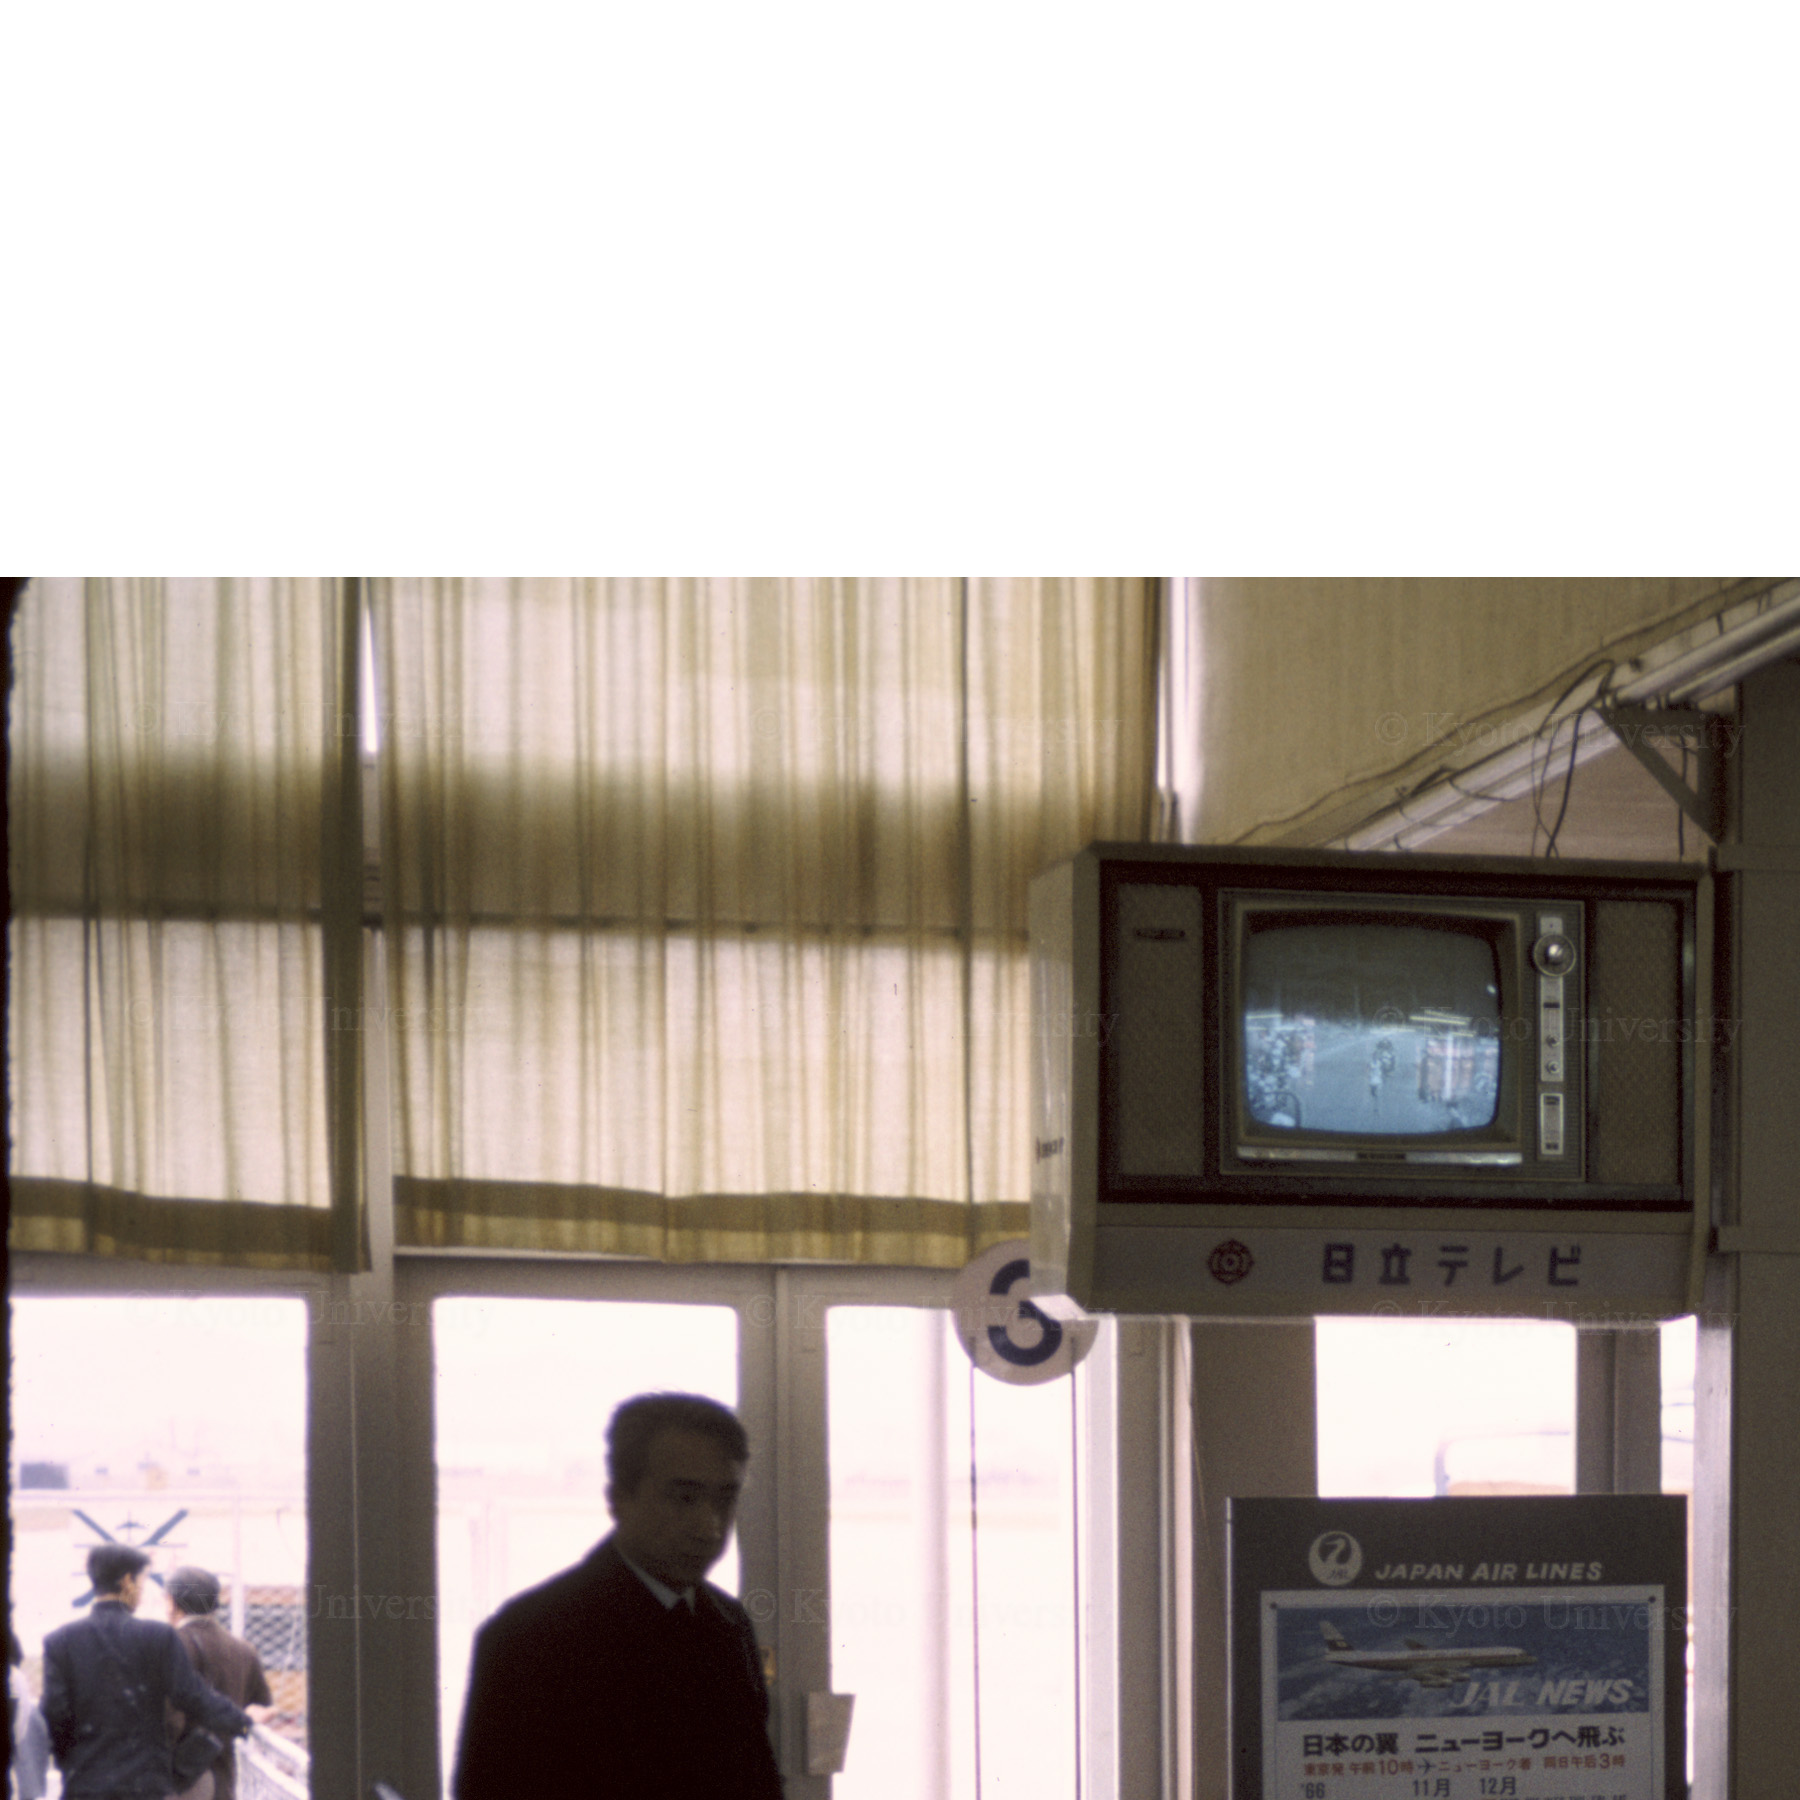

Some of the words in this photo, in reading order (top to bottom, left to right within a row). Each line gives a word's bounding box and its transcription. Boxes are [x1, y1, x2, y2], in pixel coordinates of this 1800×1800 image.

[1322, 1243, 1581, 1287] 日立テレビ
[1374, 1563, 1466, 1582] JAPAN
[1471, 1563, 1518, 1582] AIR
[1526, 1560, 1603, 1580] LINES
[1449, 1681, 1526, 1708] JAL
[1537, 1678, 1634, 1705] NEWS
[1302, 1732, 1399, 1758] 日本の翼
[1415, 1726, 1626, 1754] ニューヨークへ飛ぶ
[1413, 1778, 1450, 1797] 11月
[1480, 1776, 1516, 1795] 12月
